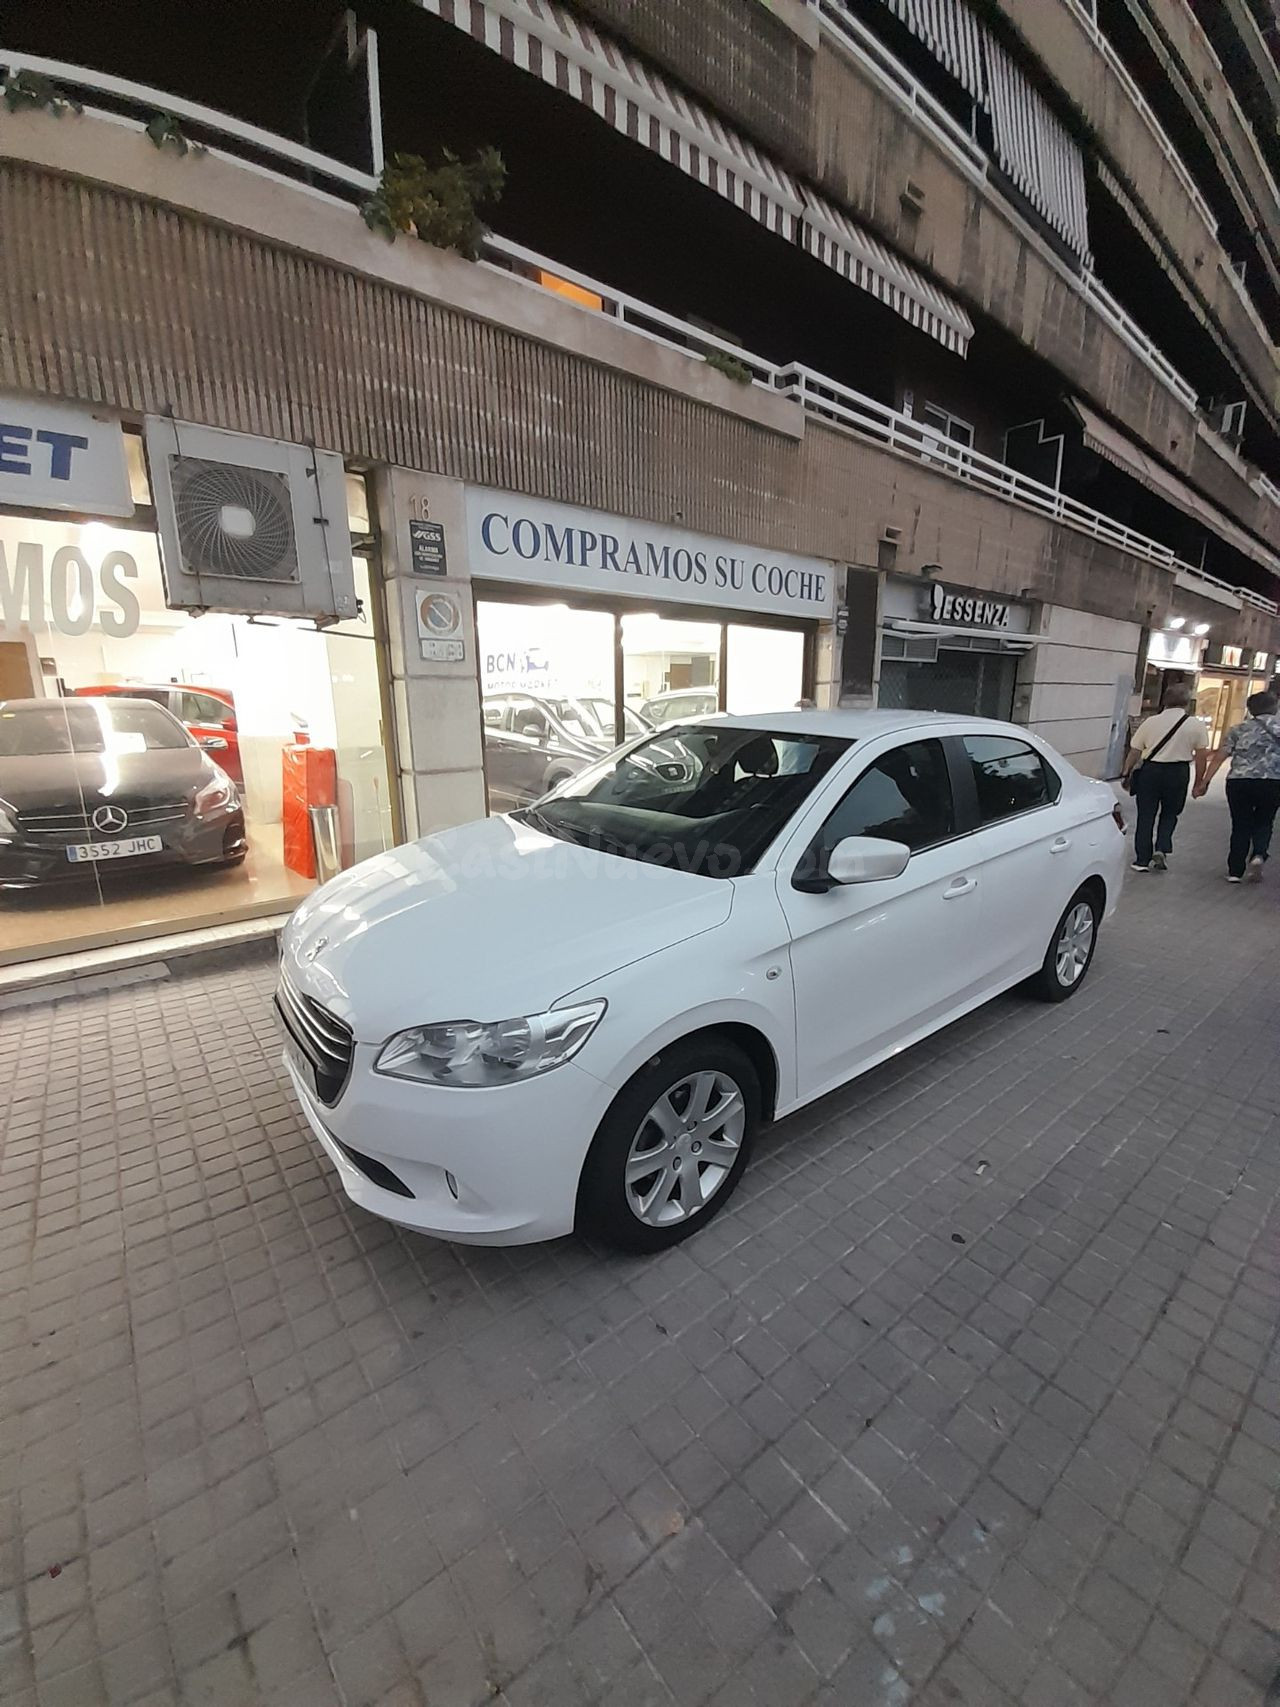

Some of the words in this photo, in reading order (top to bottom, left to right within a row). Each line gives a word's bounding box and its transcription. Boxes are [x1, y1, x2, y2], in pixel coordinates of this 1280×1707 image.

[410, 495, 431, 520] 18
[481, 513, 707, 585] COMPRAMOS
[715, 555, 745, 590] SU
[752, 563, 826, 602] COCHE
[0, 539, 140, 638] MOS
[943, 595, 1010, 627] ESSENZA
[486, 653, 516, 673] BCN
[79, 844, 120, 859] 3552
[128, 838, 156, 853] JHC
